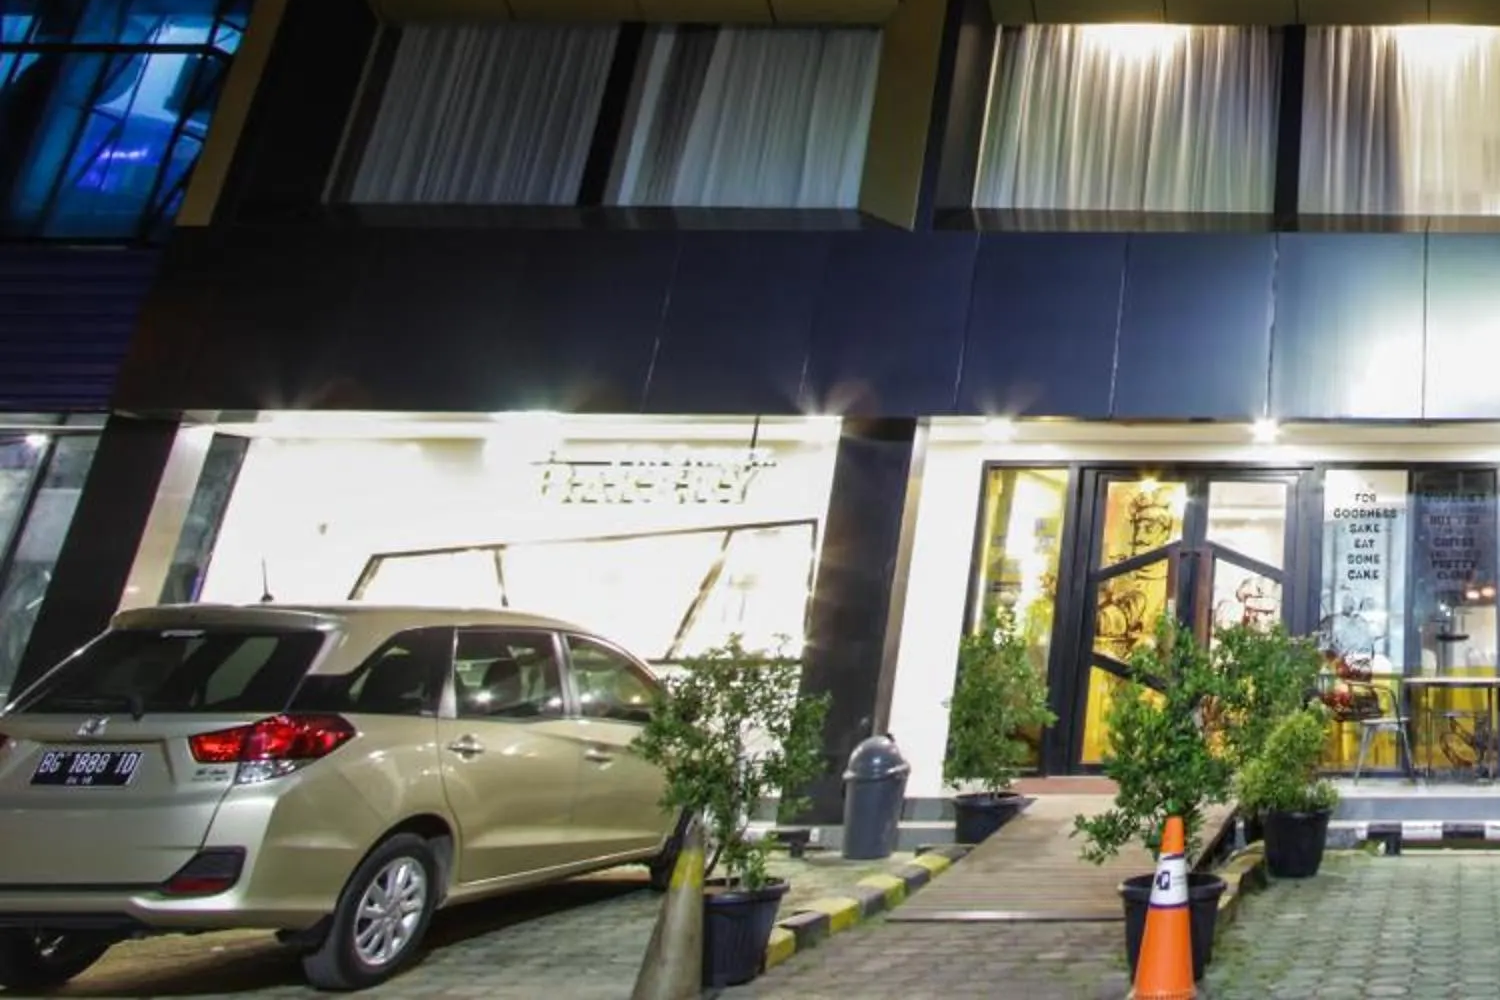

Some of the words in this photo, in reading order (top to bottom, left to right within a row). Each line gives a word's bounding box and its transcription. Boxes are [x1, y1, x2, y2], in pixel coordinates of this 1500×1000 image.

[1333, 508, 1398, 519] GOODNESS
[1349, 523, 1381, 534] SAKE
[1354, 539, 1375, 549] EAT
[1347, 554, 1381, 565] SOME
[1347, 570, 1380, 580] CAKE
[39, 753, 65, 773] BG
[68, 753, 111, 773] 1888
